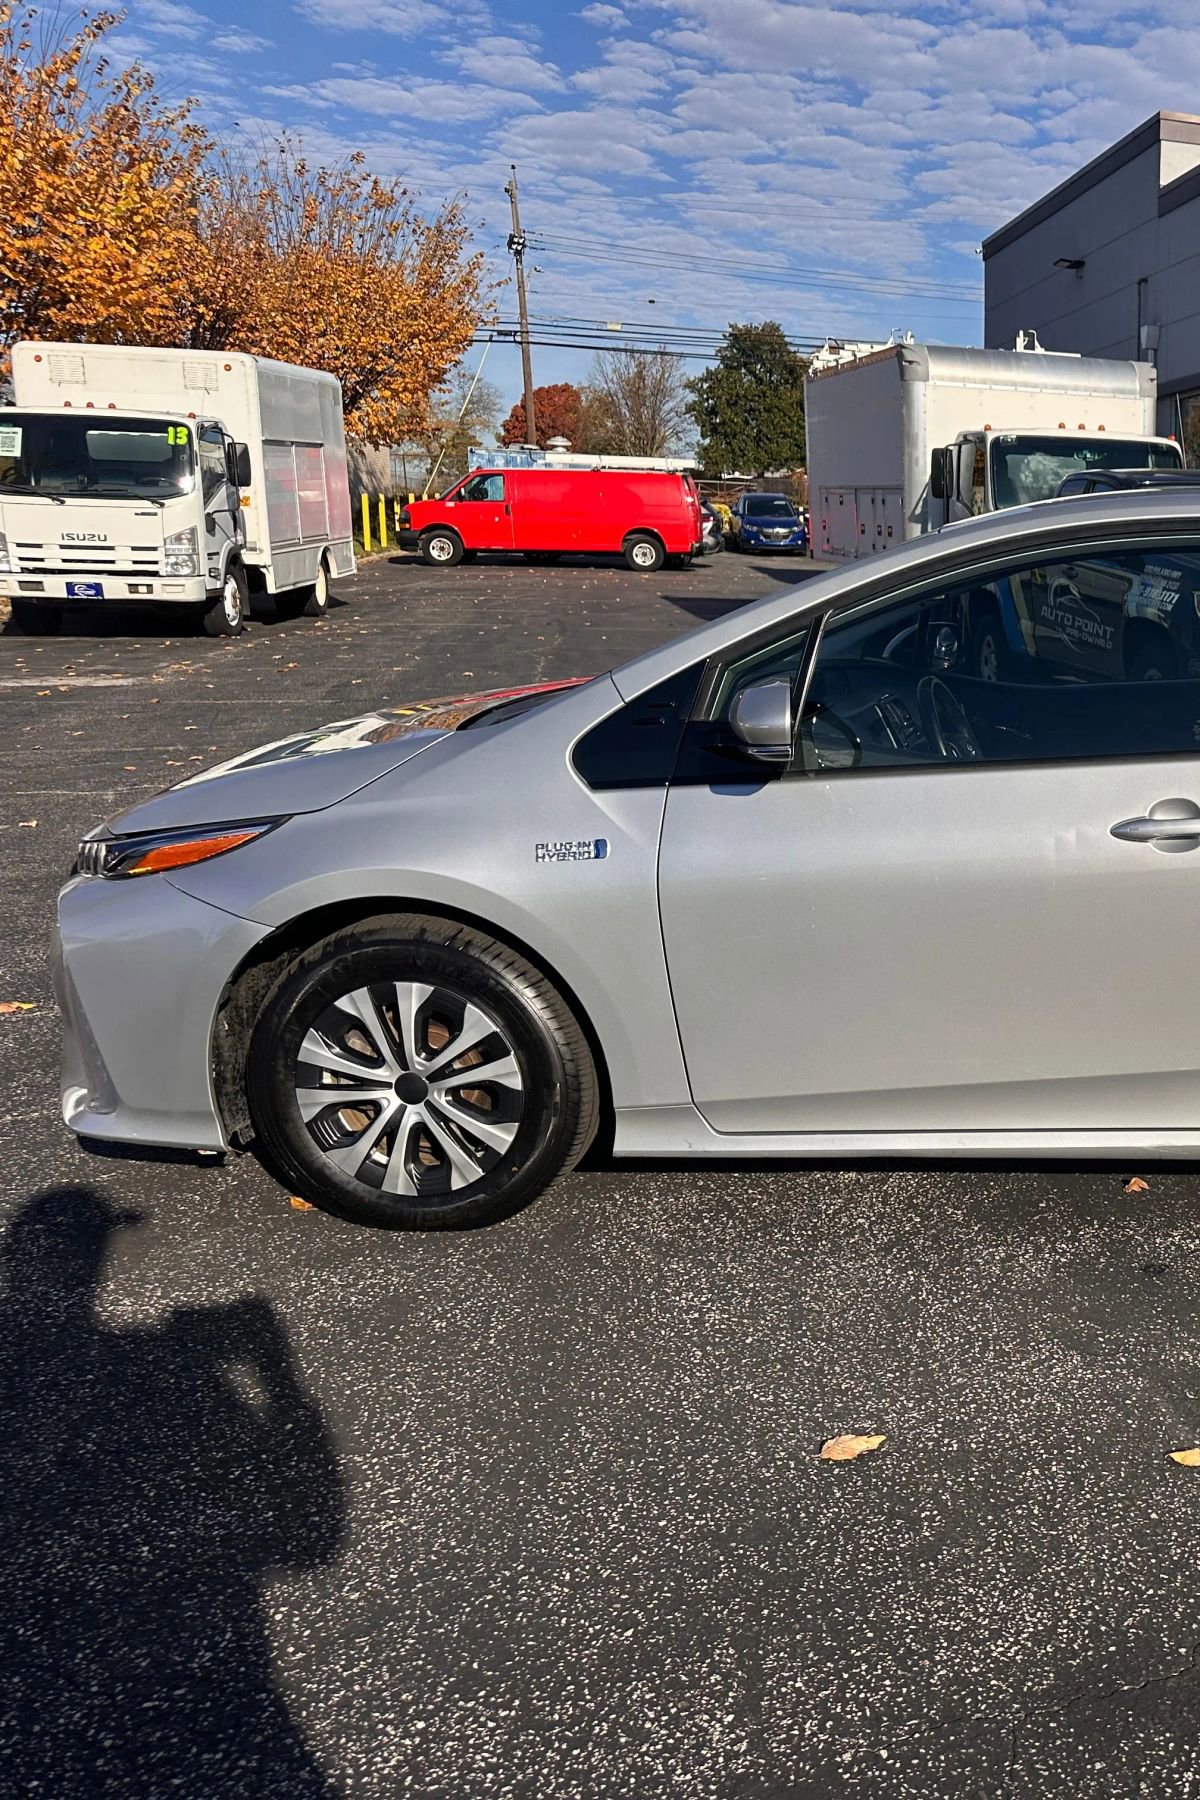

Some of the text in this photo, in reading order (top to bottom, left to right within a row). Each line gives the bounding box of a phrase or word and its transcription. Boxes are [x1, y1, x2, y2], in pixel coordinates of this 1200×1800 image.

[167, 426, 189, 446] 13
[61, 532, 108, 542] ISUZU
[1040, 605, 1115, 640] AUTO POINT
[535, 841, 591, 852] PLUG-IN
[535, 851, 592, 862] HYBRID
